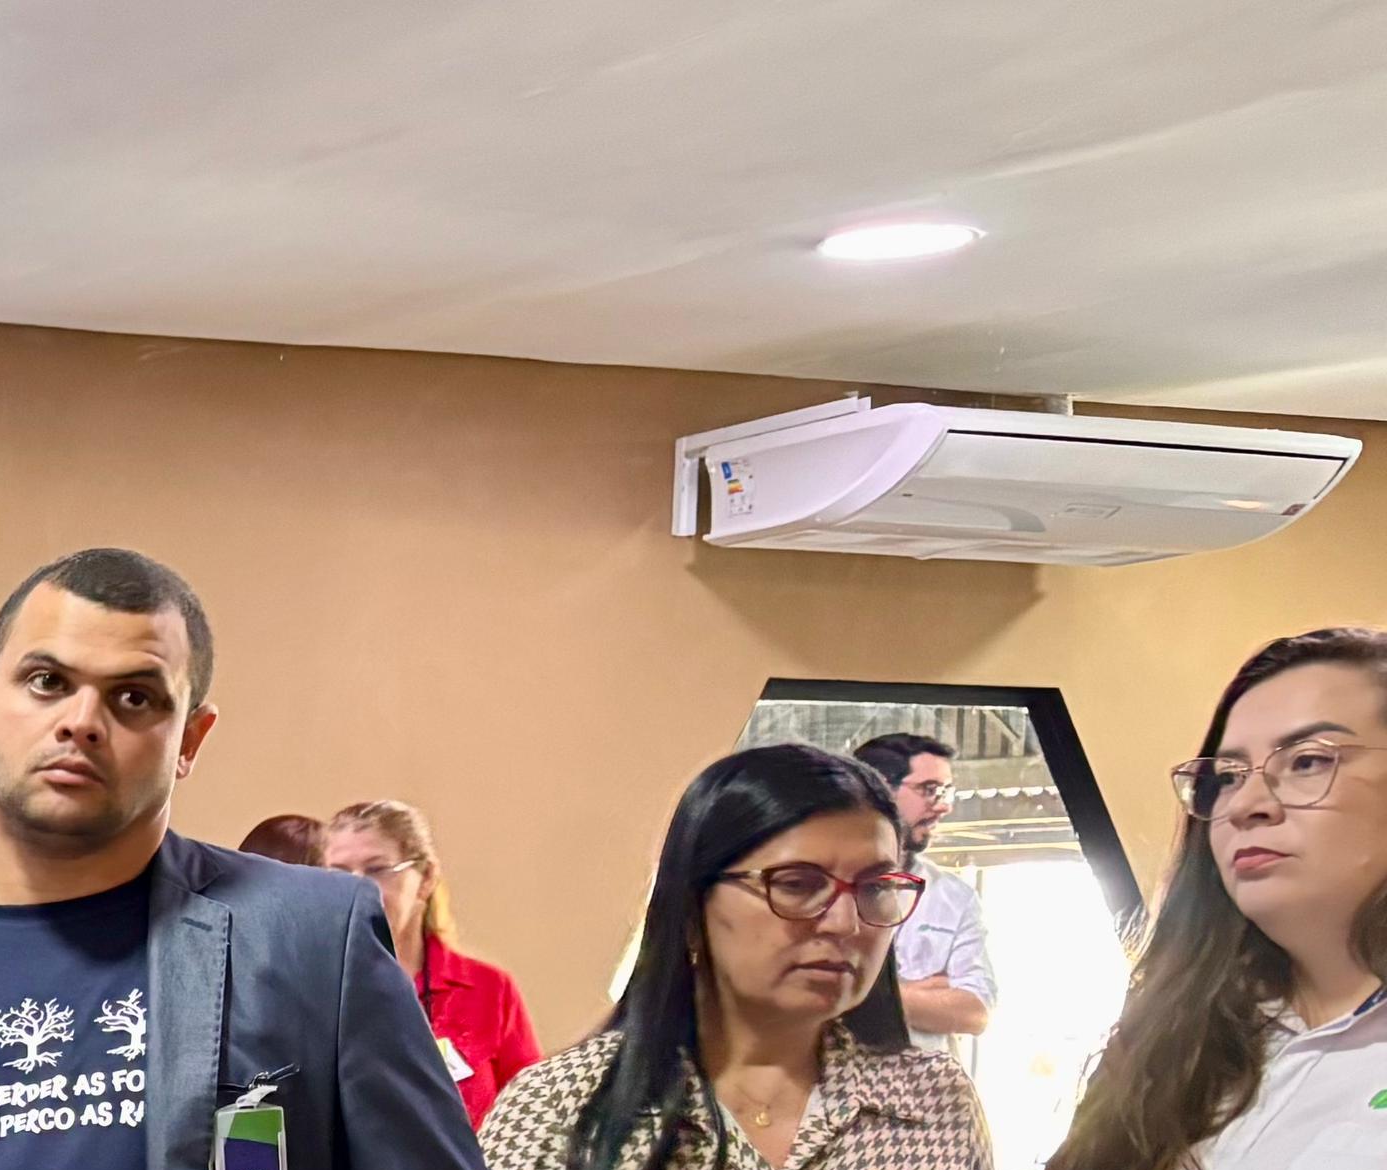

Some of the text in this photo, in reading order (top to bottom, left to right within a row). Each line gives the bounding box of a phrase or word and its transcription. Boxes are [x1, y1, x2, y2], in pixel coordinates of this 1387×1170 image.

[73, 1072, 105, 1096] AS
[0, 1107, 75, 1138] PERCO
[80, 1102, 113, 1127] AS
